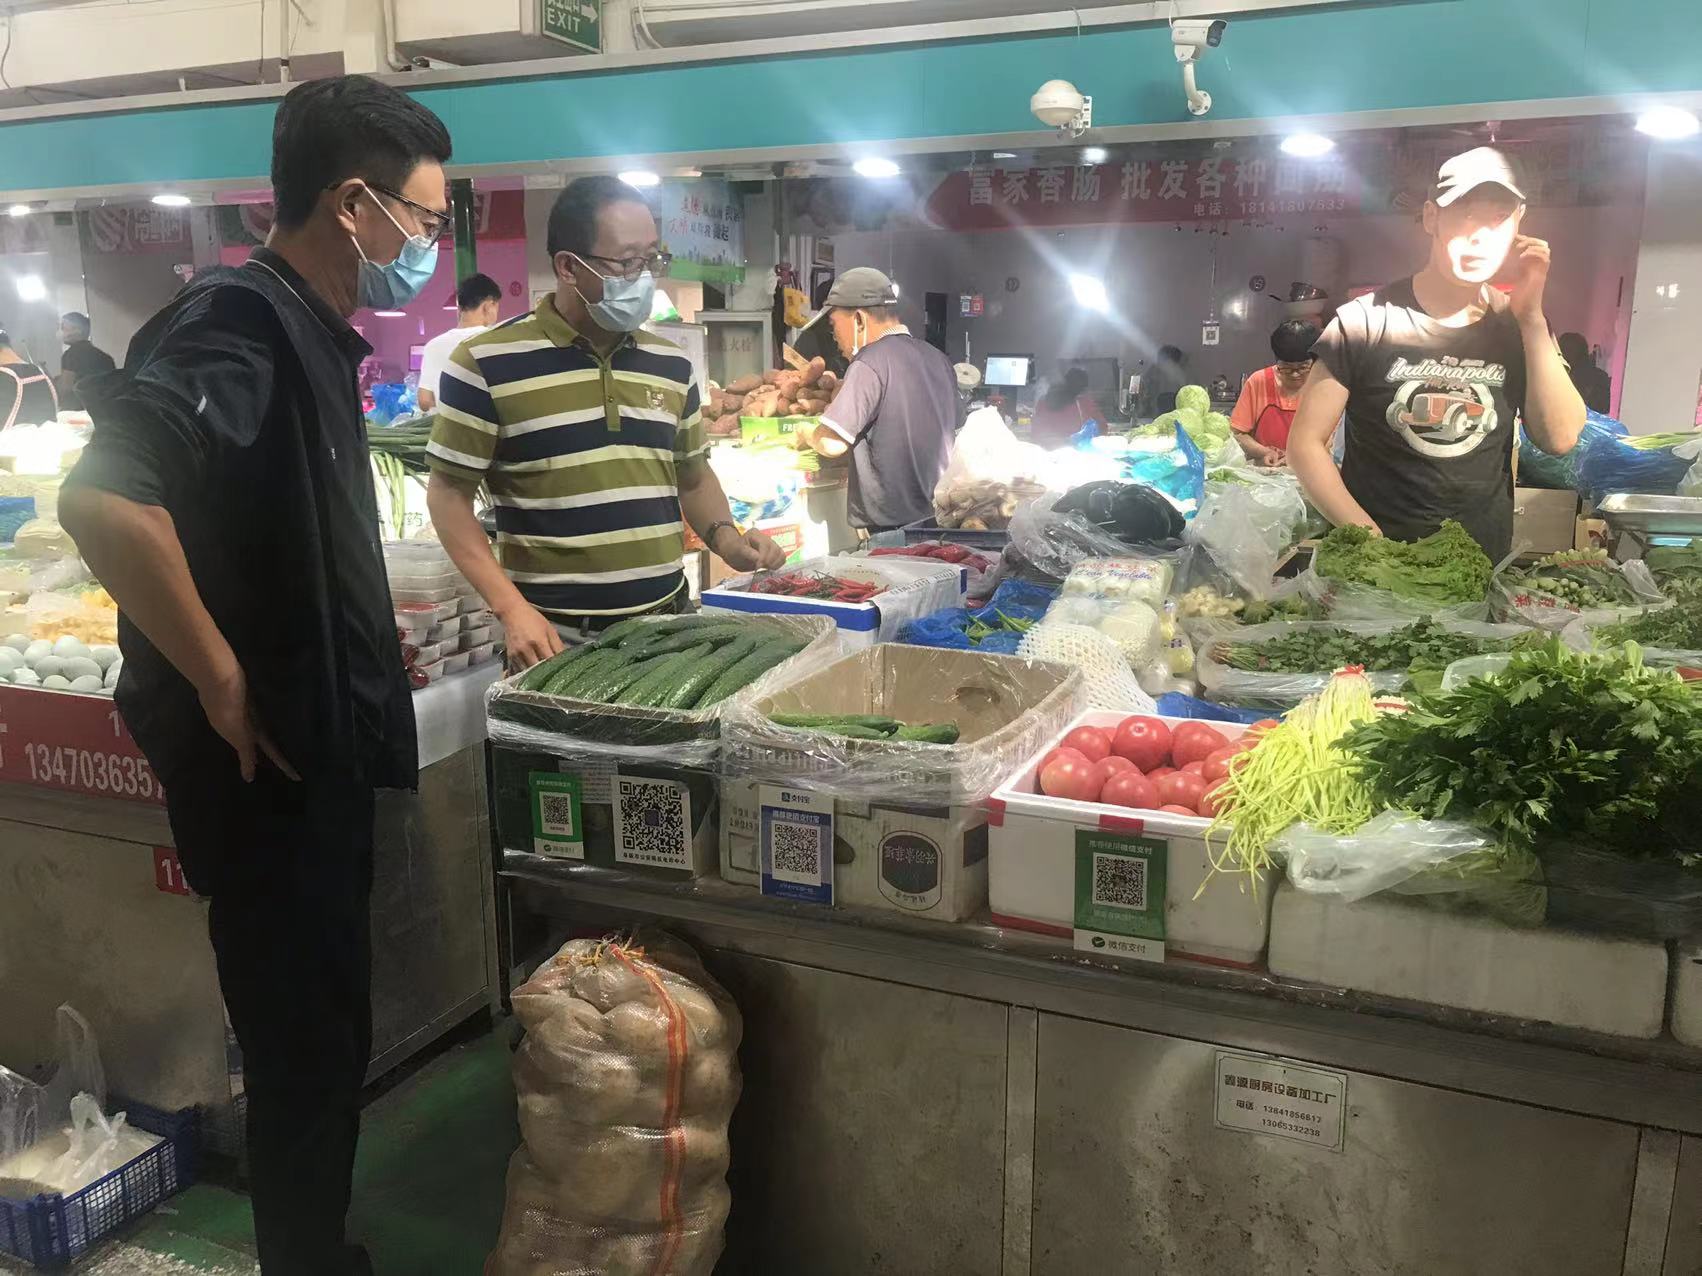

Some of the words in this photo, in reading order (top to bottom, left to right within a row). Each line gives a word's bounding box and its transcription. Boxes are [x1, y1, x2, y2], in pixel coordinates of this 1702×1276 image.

[547, 7, 580, 33] EXIT
[1385, 356, 1506, 387] Indianapolis
[1108, 940, 1146, 954] 微信支付
[1224, 1074, 1337, 1104] 鑫源厨房设备加工厂
[1261, 1118, 1321, 1137] 13065332238
